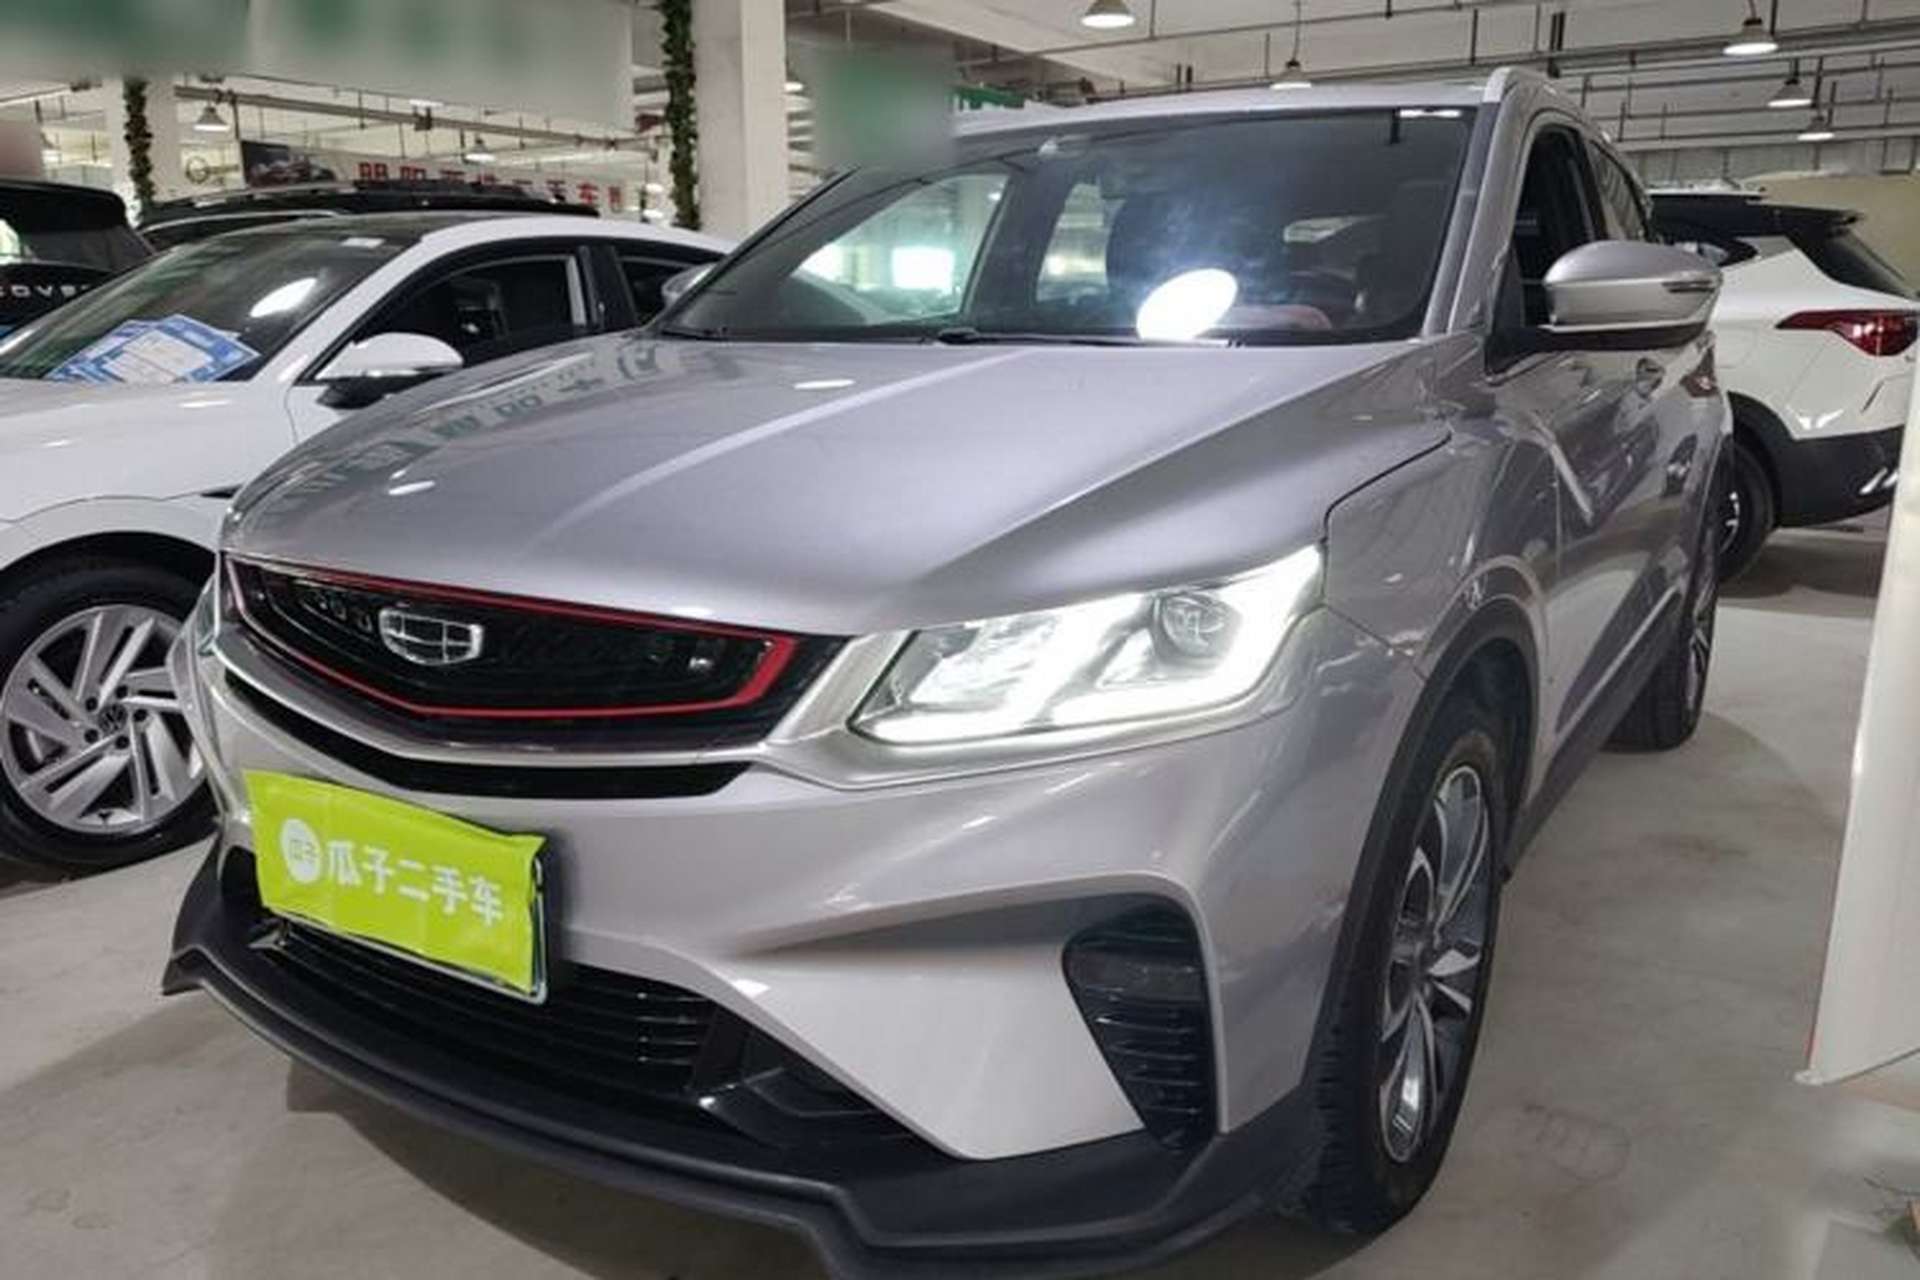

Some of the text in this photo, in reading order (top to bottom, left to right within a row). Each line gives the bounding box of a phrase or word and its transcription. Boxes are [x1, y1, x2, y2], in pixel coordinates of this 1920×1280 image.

[327, 840, 504, 927] 瓜子二手车
